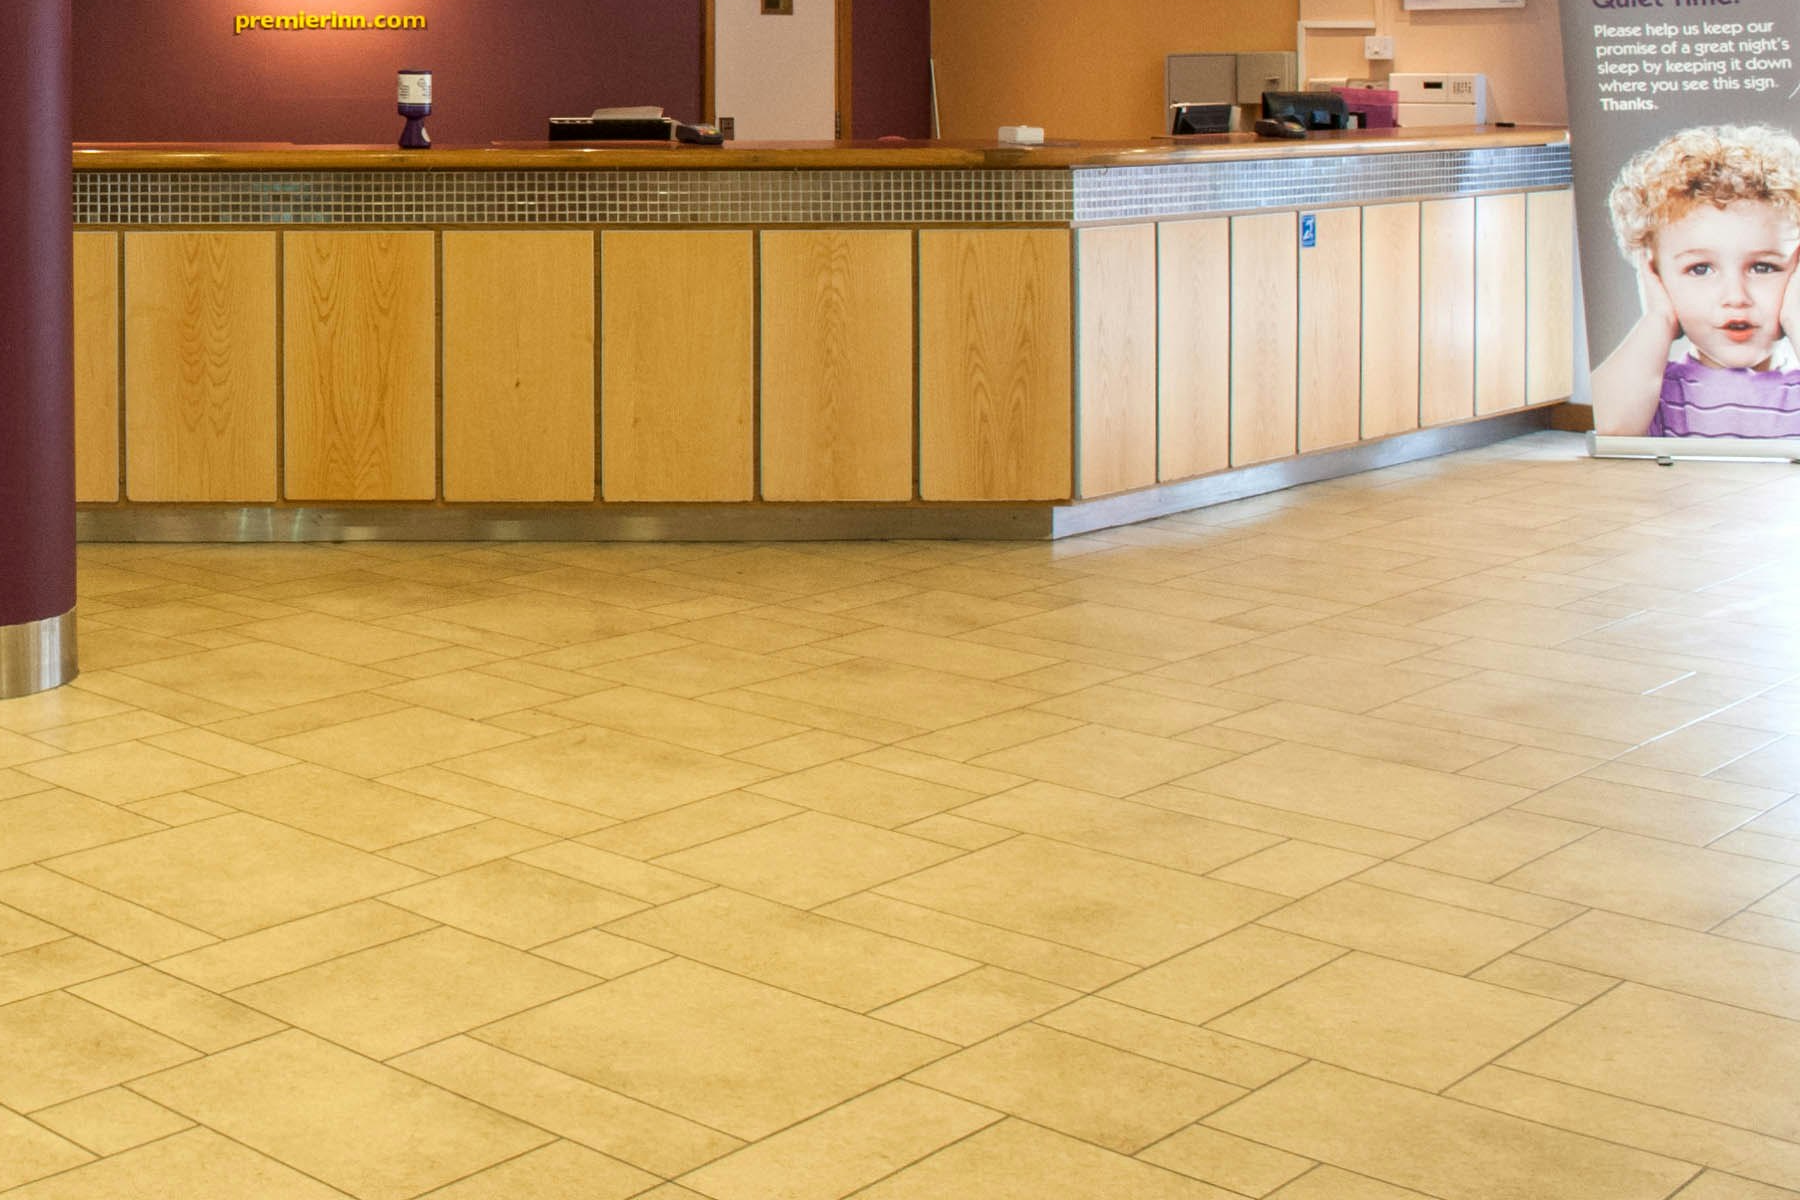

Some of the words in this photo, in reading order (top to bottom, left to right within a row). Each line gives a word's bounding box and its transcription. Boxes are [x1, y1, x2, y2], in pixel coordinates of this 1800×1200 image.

[234, 11, 426, 34] premierinn.com
[1593, 24, 1642, 38] Please
[1646, 23, 1679, 38] help
[1683, 24, 1700, 36] us
[1703, 22, 1743, 36] keep
[1746, 22, 1775, 34] our
[1595, 42, 1657, 59] promise
[1660, 40, 1679, 55] of
[1681, 43, 1691, 54] a
[1694, 40, 1735, 57] great
[1739, 37, 1790, 55] night's
[1597, 61, 1640, 76] sleep
[1643, 60, 1663, 75] by
[1665, 59, 1727, 75] keeping
[1730, 58, 1742, 71] it
[1745, 56, 1792, 71] down
[1599, 79, 1647, 93] where
[1650, 80, 1679, 94] you
[1682, 79, 1710, 91] see
[1712, 77, 1740, 90] this
[1743, 76, 1780, 91] sign.
[1600, 97, 1659, 112] Thanks.
